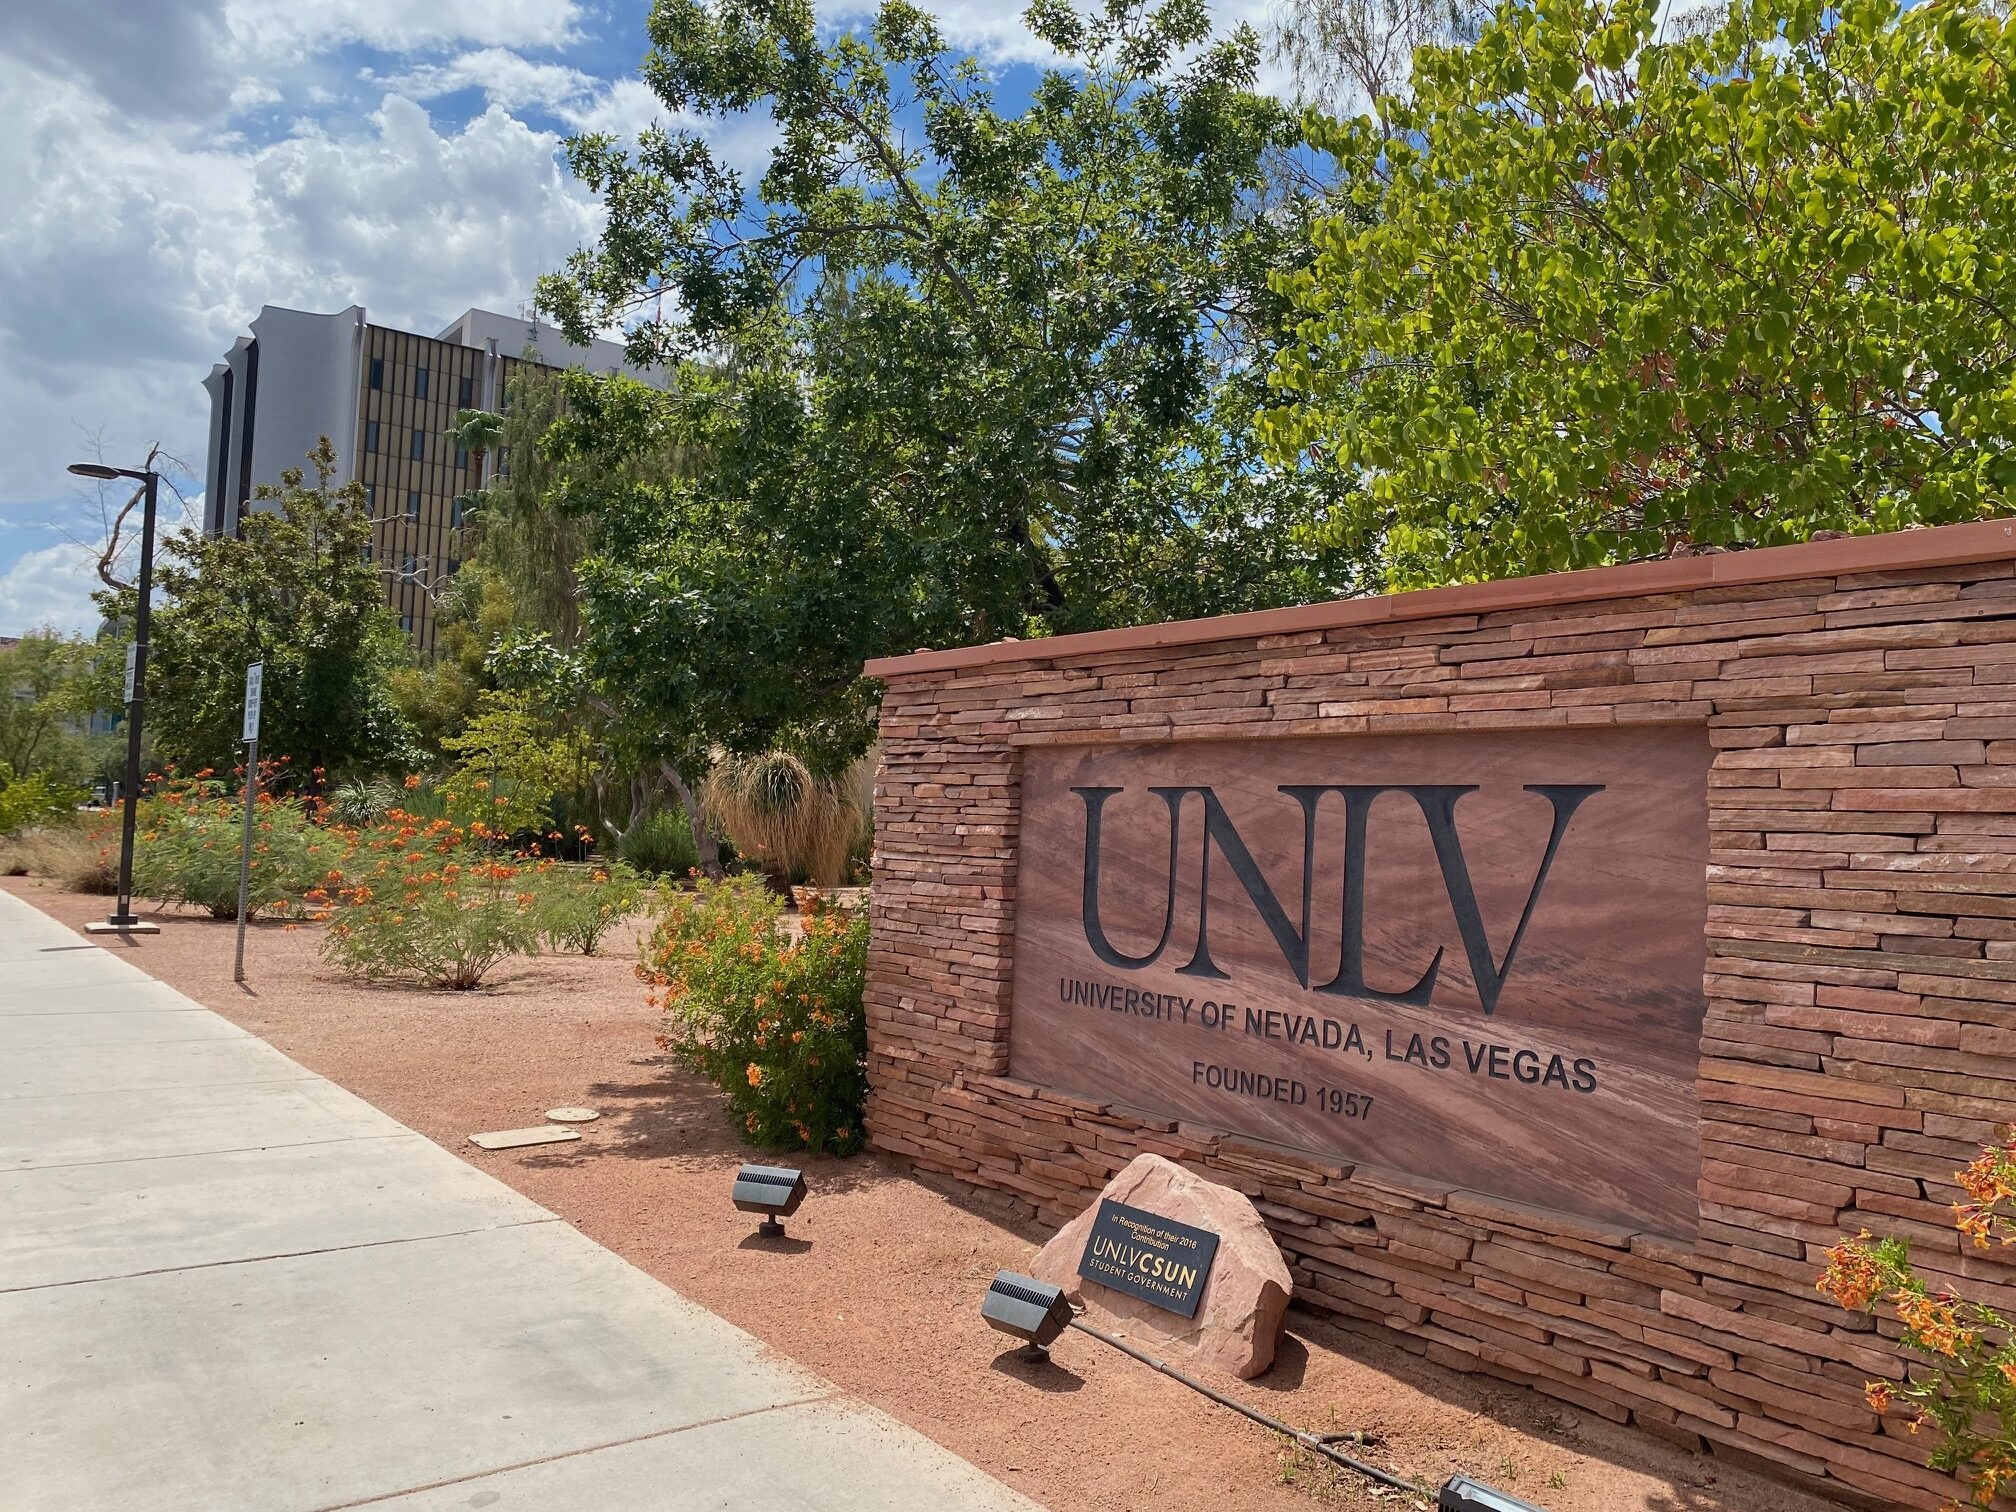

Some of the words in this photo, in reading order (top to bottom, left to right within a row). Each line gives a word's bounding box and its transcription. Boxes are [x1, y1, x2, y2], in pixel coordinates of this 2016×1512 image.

[1070, 784, 1606, 1016] UNLV
[1060, 978, 1194, 1024] UNIVERSITY
[1201, 1001, 1236, 1030] OF
[1245, 1007, 1373, 1062] NEVADA,
[1385, 1029, 1450, 1070] LAS
[1463, 1040, 1597, 1094] VEGAS
[1192, 1061, 1307, 1105] FOUNDED
[1316, 1086, 1374, 1120] 1957
[1111, 1214, 1118, 1223] In
[1119, 1216, 1156, 1235] Recognition
[1156, 1230, 1165, 1238] of
[1163, 1231, 1179, 1244] their
[1179, 1236, 1198, 1250] 2016
[1131, 1231, 1170, 1251] Contribution
[1089, 1258, 1126, 1278] STUDENT
[1127, 1272, 1188, 1301] GOVERNMENT
[1093, 1235, 1197, 1290] UNLVCSUN
